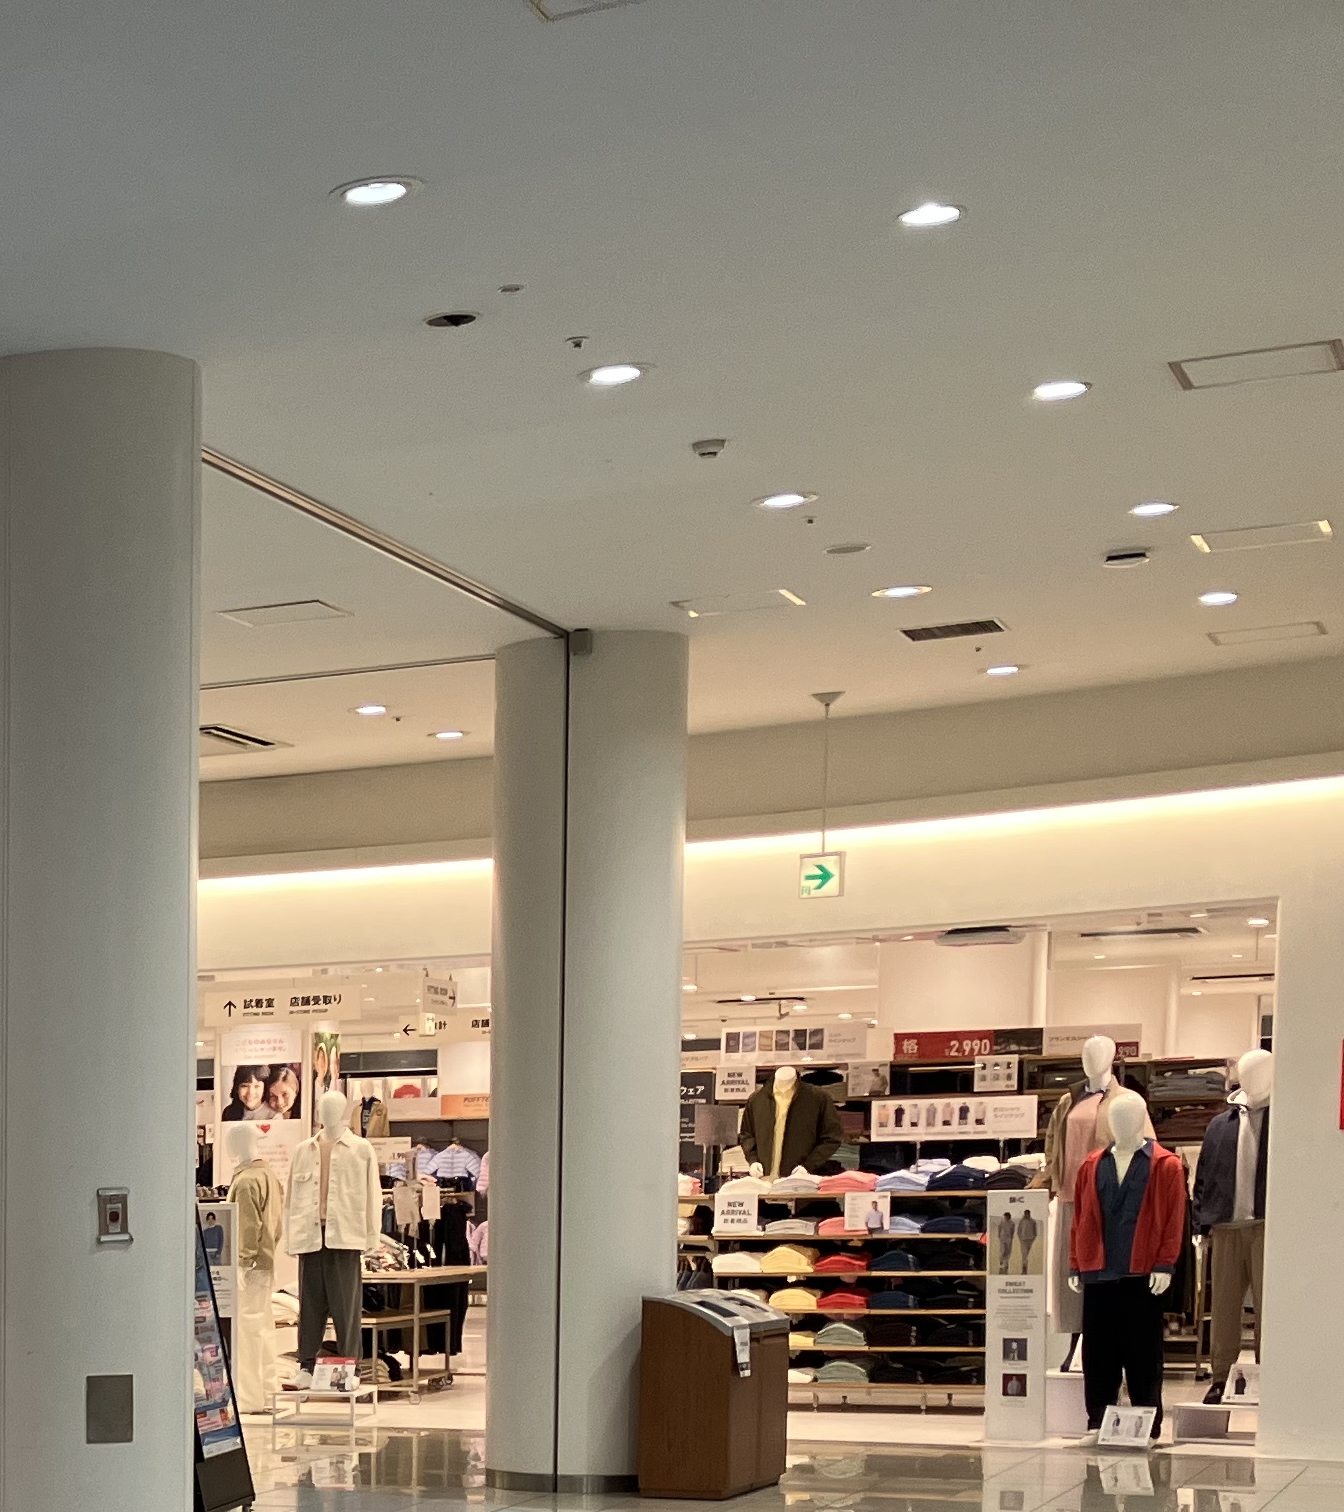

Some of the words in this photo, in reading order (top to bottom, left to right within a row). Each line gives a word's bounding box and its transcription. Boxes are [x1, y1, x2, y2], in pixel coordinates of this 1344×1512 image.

[242, 997, 275, 1009] 試着室
[288, 993, 342, 1007] 店舗受取り
